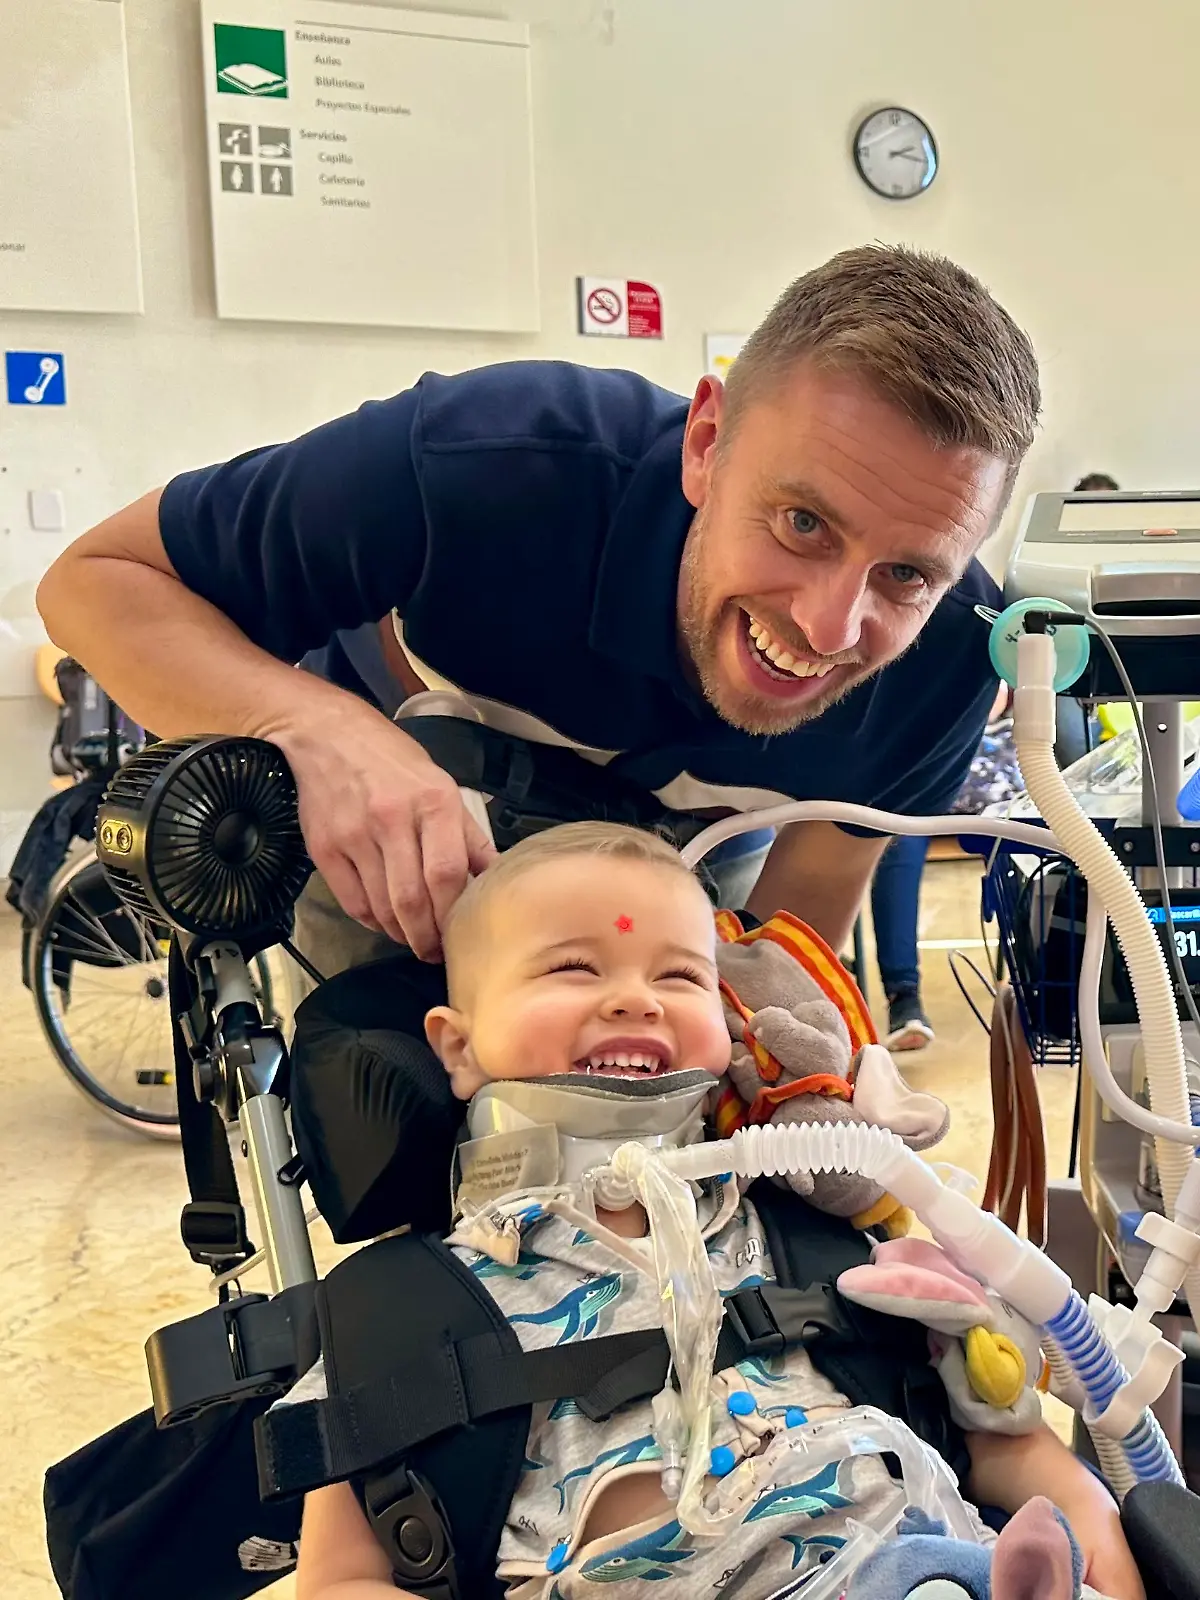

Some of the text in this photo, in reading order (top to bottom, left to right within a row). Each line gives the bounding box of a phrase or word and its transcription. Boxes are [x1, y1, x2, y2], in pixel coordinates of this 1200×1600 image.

[315, 76, 365, 90] Biblioteca
[315, 98, 363, 112] Proyectos
[299, 128, 347, 143] Servicios
